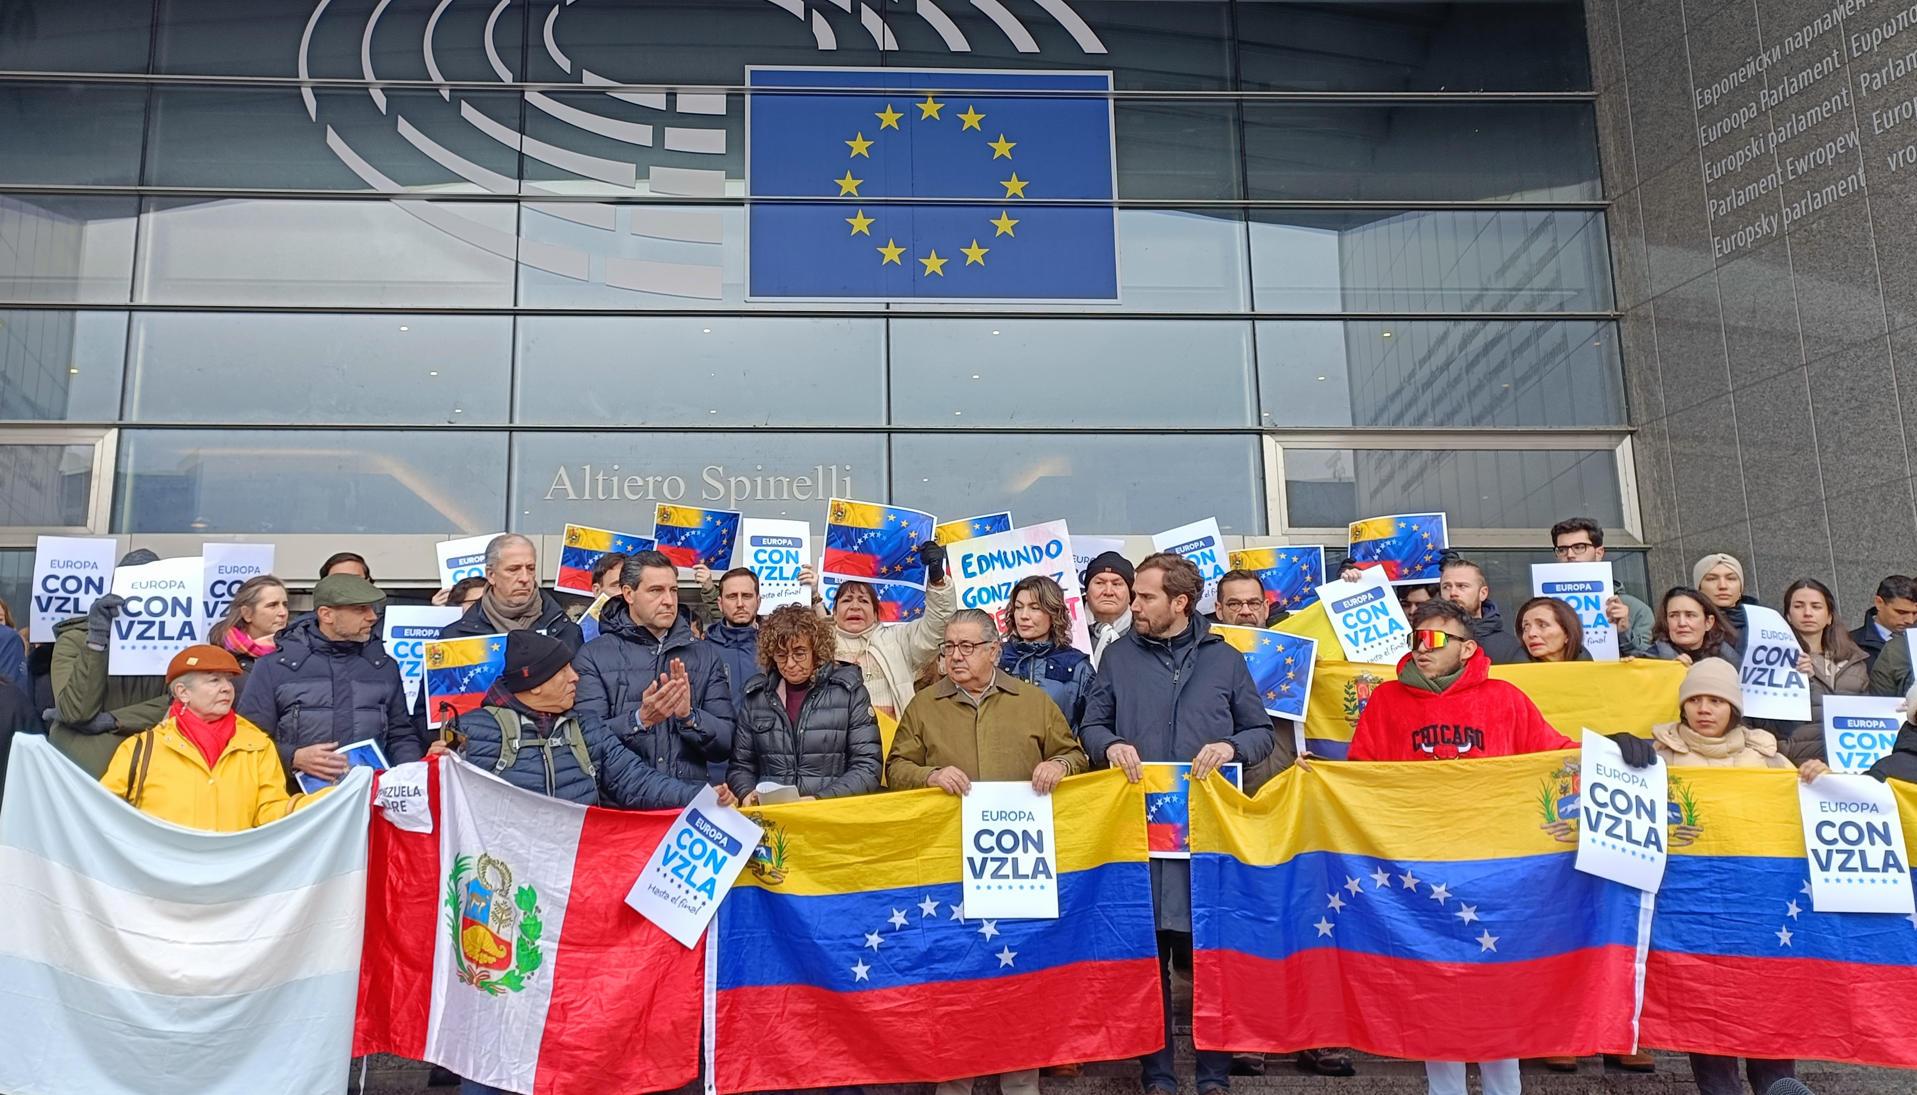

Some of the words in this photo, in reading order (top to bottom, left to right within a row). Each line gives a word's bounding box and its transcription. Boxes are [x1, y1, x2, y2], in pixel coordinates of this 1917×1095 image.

[1696, 45, 1781, 110] Европейски
[1784, 0, 1873, 55] парламен
[1700, 102, 1757, 148] Euroopa
[1760, 49, 1841, 112] Parlament
[1705, 133, 1765, 184] Europski
[1768, 87, 1850, 153] parlament
[1709, 166, 1783, 221] Parlament
[1786, 128, 1860, 182] Ewropew
[1714, 212, 1779, 259] Európsky
[1783, 166, 1866, 225] parlament
[543, 464, 686, 500] Altiero
[702, 464, 852, 510] Spinelli
[762, 538, 793, 546] EUROPA
[1175, 541, 1206, 554] EUROPA
[50, 559, 98, 570] EUROPA
[458, 555, 486, 566] EUROP
[753, 548, 800, 564] CON
[961, 539, 1064, 579] EDMUNDO
[1186, 549, 1216, 566] ON
[218, 565, 261, 575] EUROPA
[452, 567, 484, 583] CO
[41, 574, 104, 595] CON
[131, 580, 186, 590] EUROPA
[210, 579, 245, 599] CO
[760, 591, 775, 599] asta
[962, 571, 1069, 609] GONZZ
[1555, 583, 1592, 592] EUROPA
[34, 595, 88, 615] VZL
[121, 595, 193, 618] CON
[203, 600, 233, 618] VZ
[1342, 592, 1374, 609] EUROPA
[1565, 595, 1601, 611] ON
[1342, 601, 1390, 630] CON
[114, 620, 197, 641] VZLA
[404, 628, 440, 637] EUROPA
[1344, 617, 1404, 647] VZLA
[393, 641, 423, 659] CO
[1752, 645, 1800, 669] CON
[1741, 666, 1806, 689] VZLA
[1847, 720, 1886, 728] EUROPA
[1411, 724, 1486, 752] CHICAGO
[1839, 732, 1896, 750] CON
[1596, 763, 1649, 789] EUROPA
[1589, 782, 1656, 824] CON
[1820, 801, 1879, 813] EUROPA
[981, 810, 1035, 821] EUROPA
[695, 817, 728, 847] EUROPA
[973, 828, 1044, 854] CON
[1583, 806, 1663, 853] VZLA
[1815, 820, 1893, 846] CON
[676, 828, 728, 875] CON
[1811, 848, 1906, 873] VZLA
[661, 843, 717, 900] VZLA
[966, 856, 1053, 879] VZLA
[648, 883, 670, 901] Hasta
[670, 894, 680, 906] el
[677, 897, 702, 915] final
